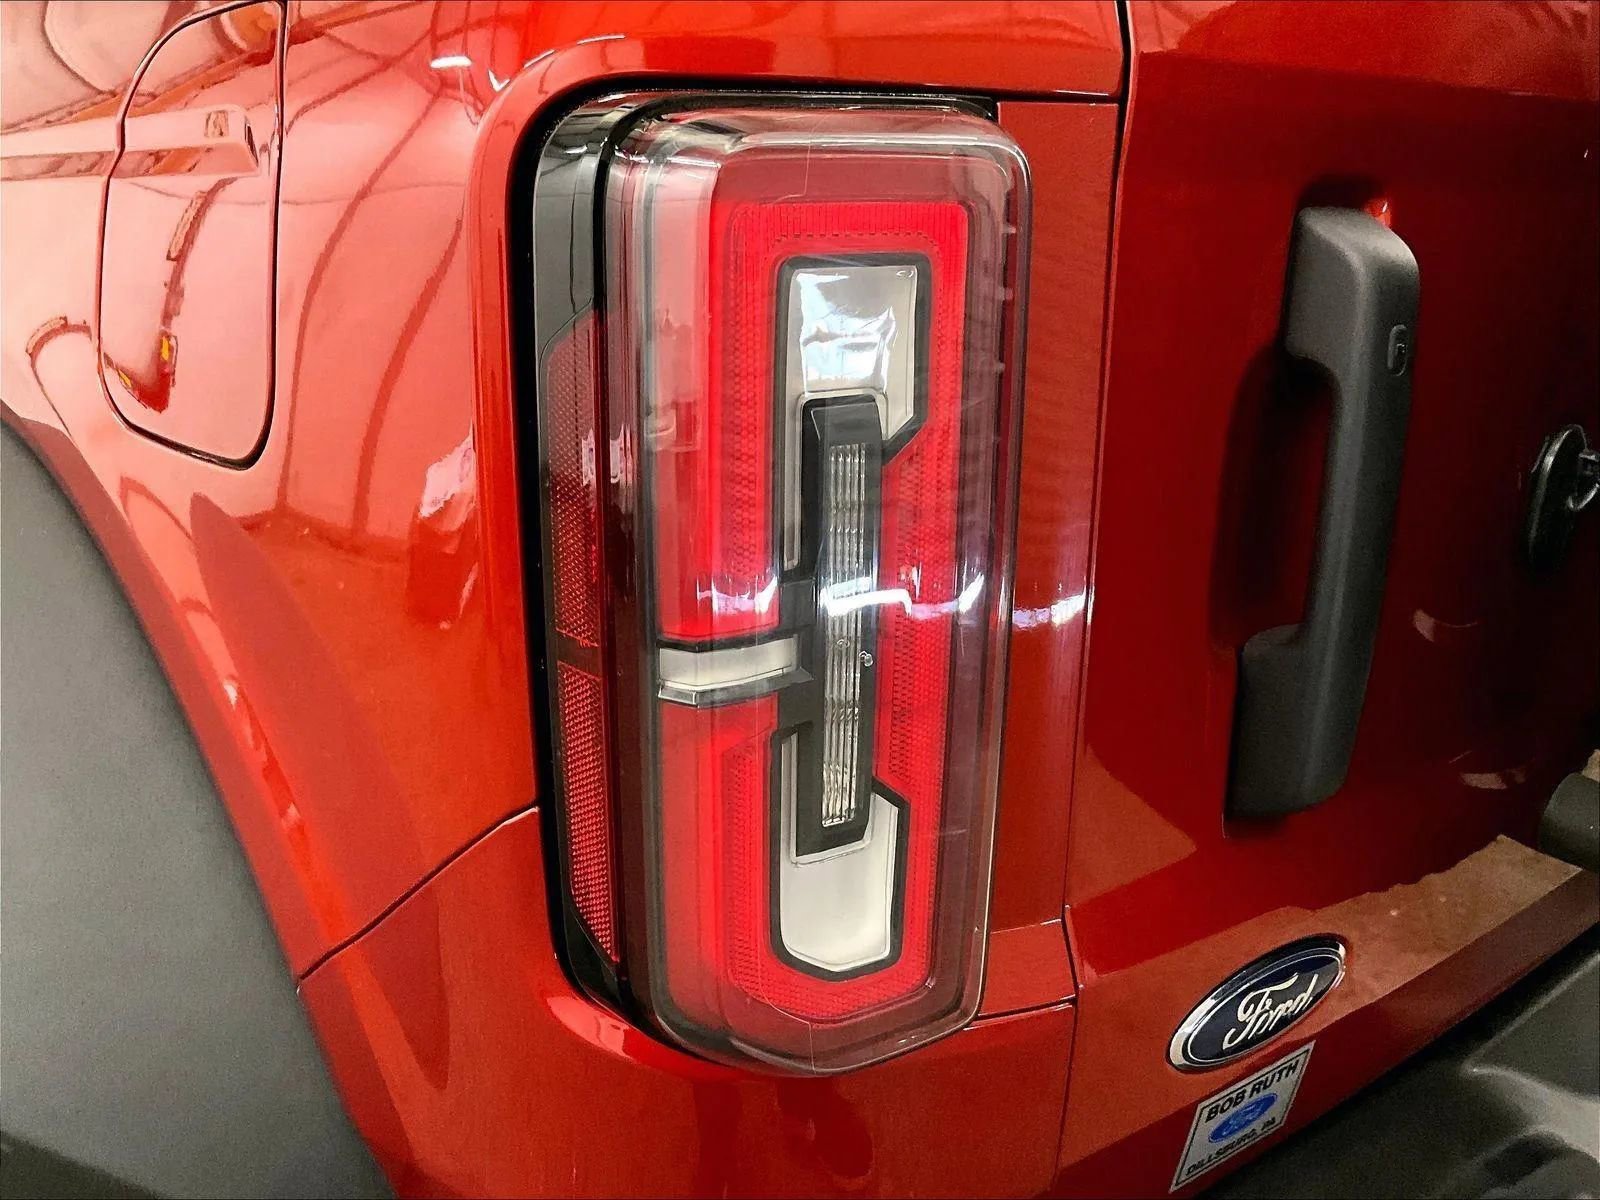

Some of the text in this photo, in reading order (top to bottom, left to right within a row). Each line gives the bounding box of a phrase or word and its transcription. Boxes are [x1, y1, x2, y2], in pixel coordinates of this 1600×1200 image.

[1222, 972, 1318, 1050] Ford
[1205, 1090, 1246, 1123] BOB
[1251, 1062, 1298, 1094] RUTH
